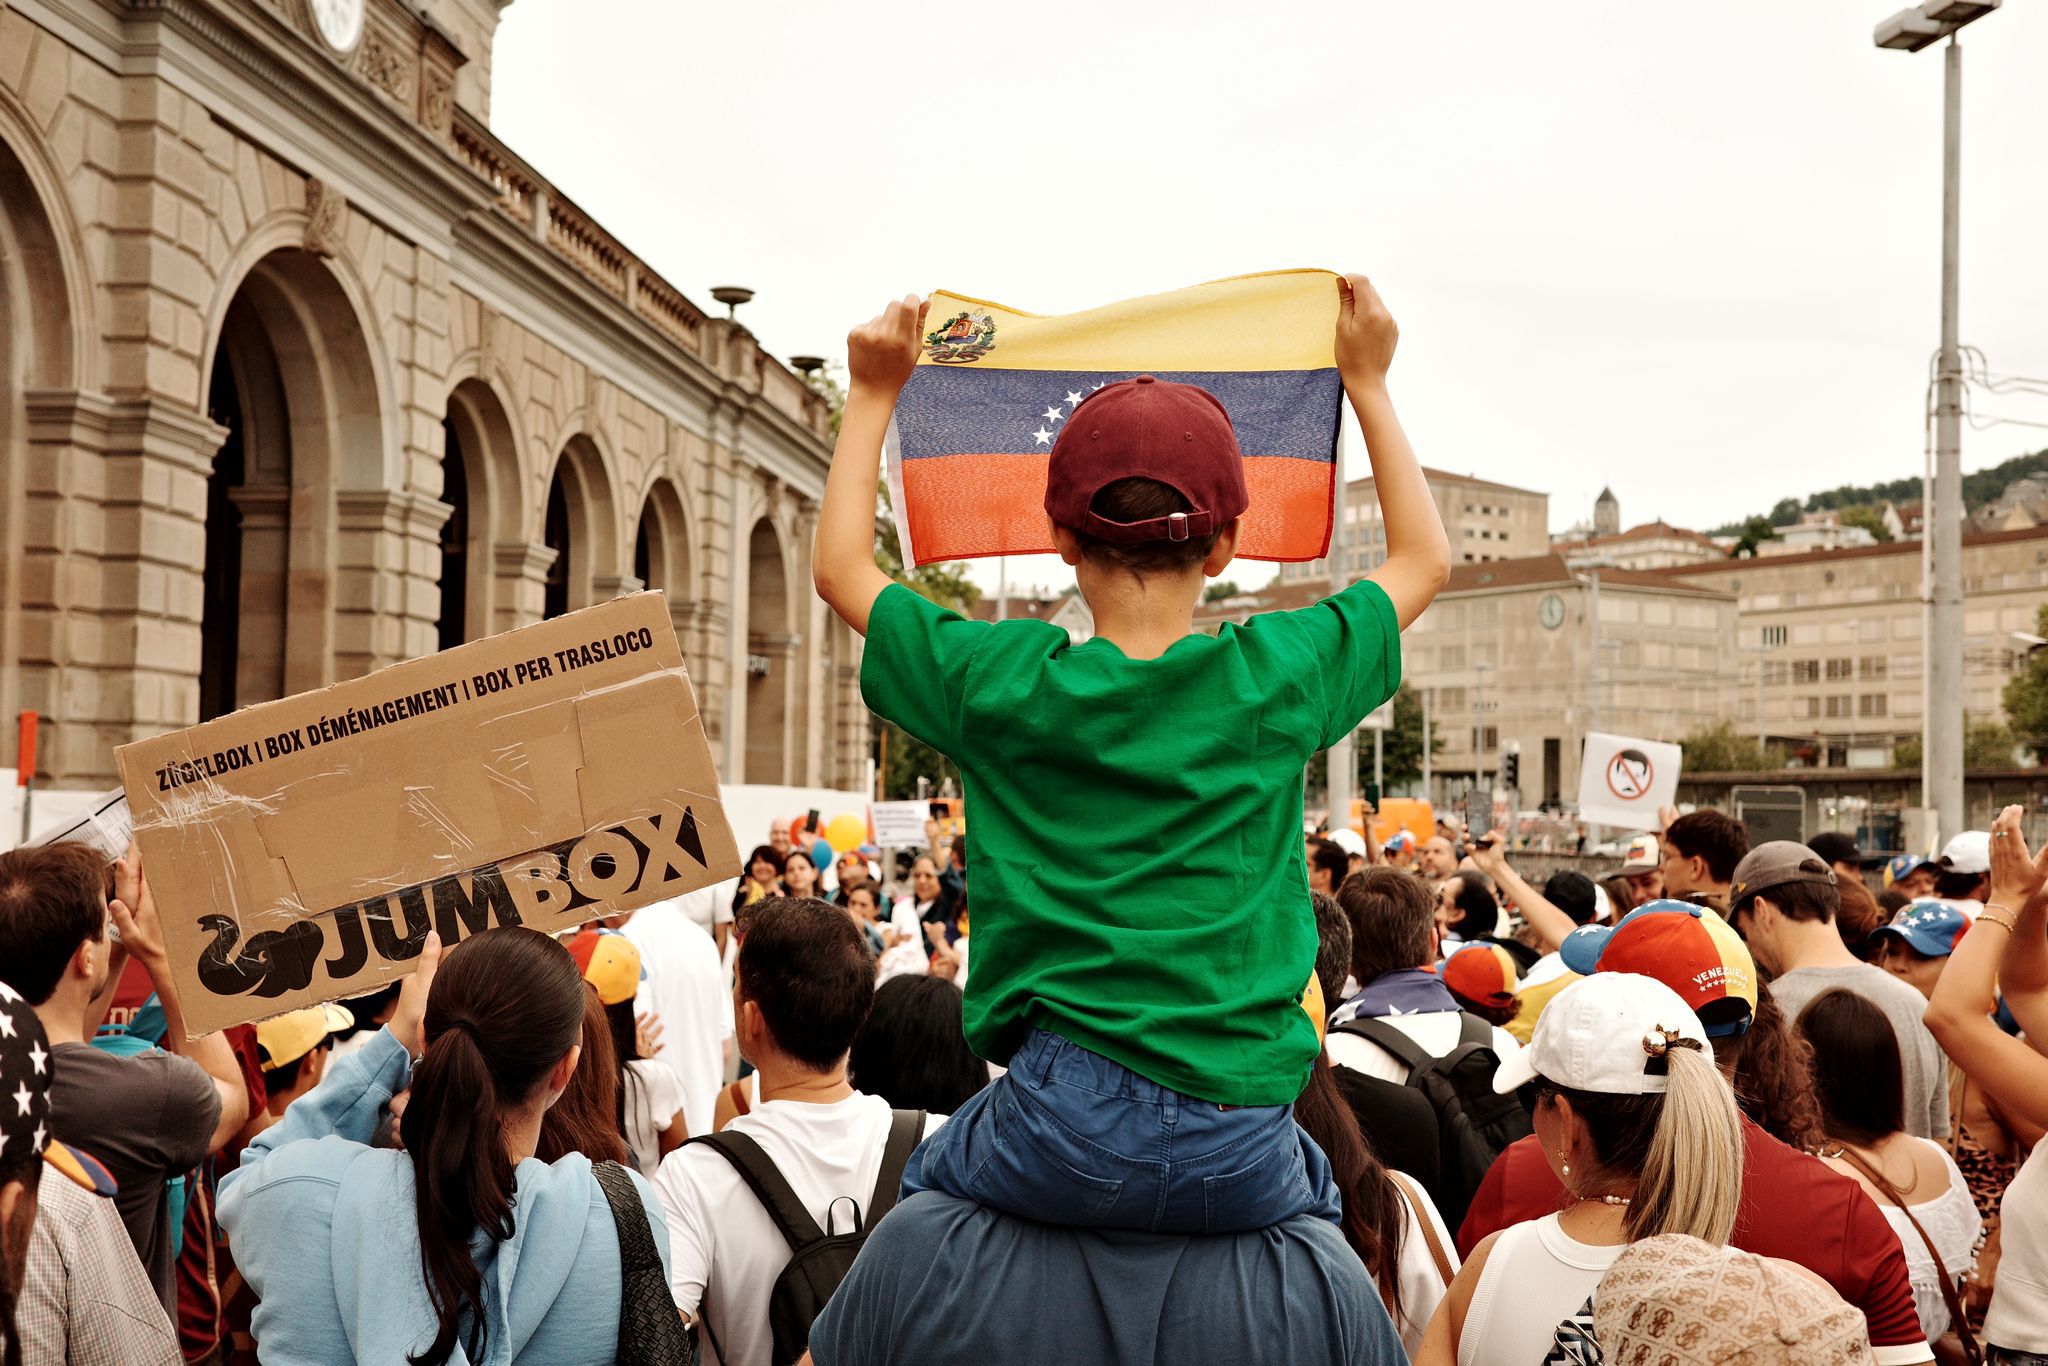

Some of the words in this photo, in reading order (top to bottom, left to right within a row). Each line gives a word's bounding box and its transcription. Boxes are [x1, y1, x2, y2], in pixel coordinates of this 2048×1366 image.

[155, 743, 254, 792] ZÜGELBOX
[264, 728, 306, 759] BOX
[306, 682, 460, 747] DÉMÉNAGEMENT
[472, 667, 514, 698] BOX
[514, 656, 554, 685] PER
[555, 627, 654, 673] TRASLOCO
[325, 805, 709, 980] JUMBOX
